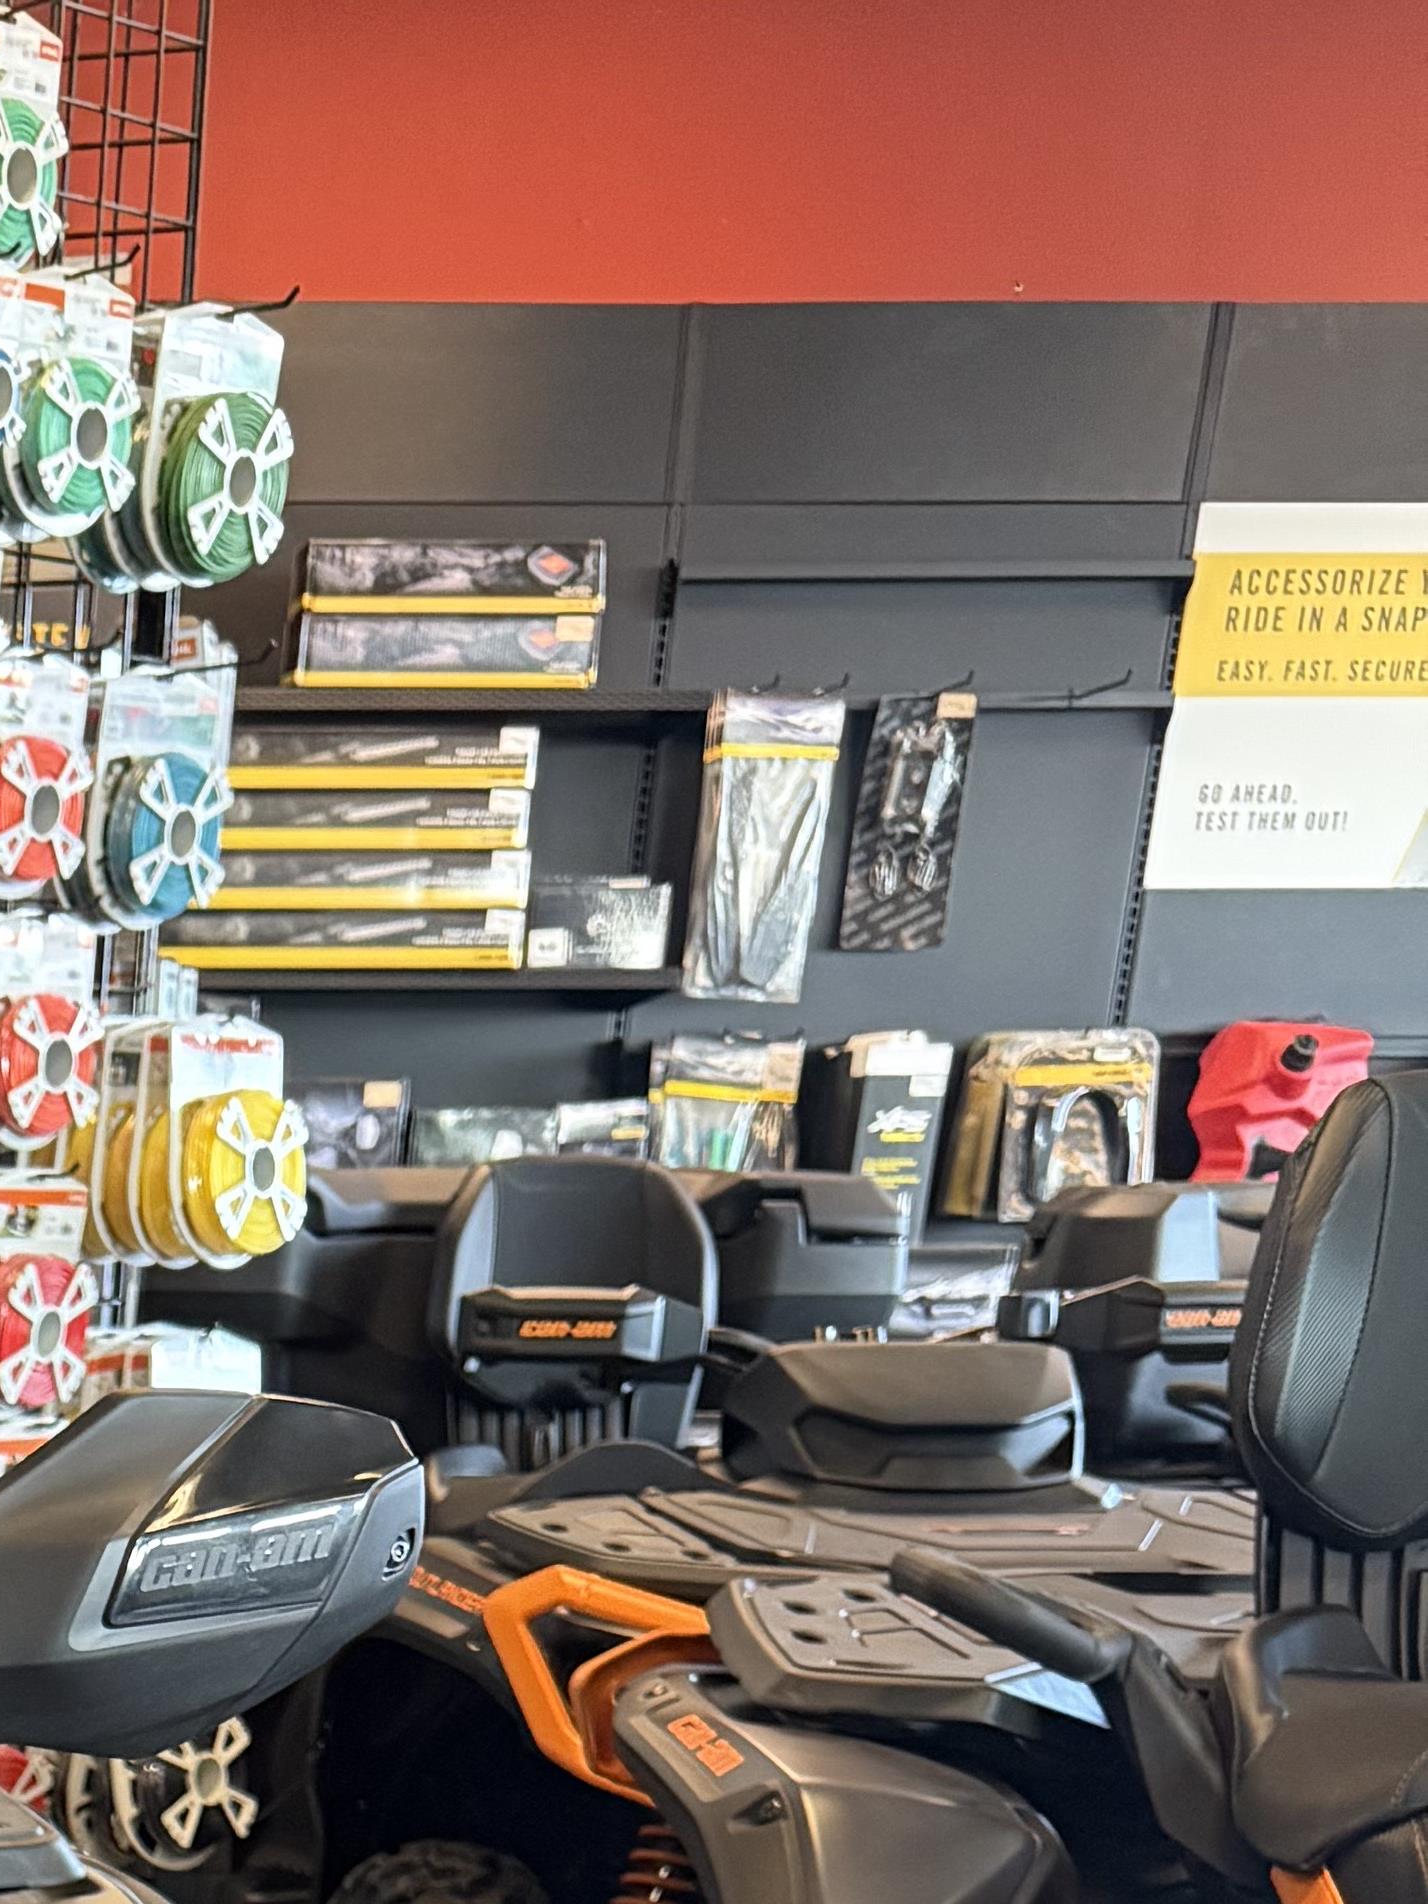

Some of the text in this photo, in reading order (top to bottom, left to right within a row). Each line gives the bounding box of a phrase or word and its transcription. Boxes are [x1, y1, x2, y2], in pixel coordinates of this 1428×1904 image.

[1229, 569, 1409, 596] ACCESSORIZE
[1225, 606, 1286, 632] RIDE
[1298, 606, 1324, 632] IN
[1335, 606, 1348, 632] A
[1217, 660, 1274, 682] EASY.
[1283, 660, 1337, 682] FAST.
[1199, 784, 1297, 804] GO AHEAD.
[1195, 811, 1348, 832] TEST THEM OUT!
[141, 1524, 334, 1592] can-am
